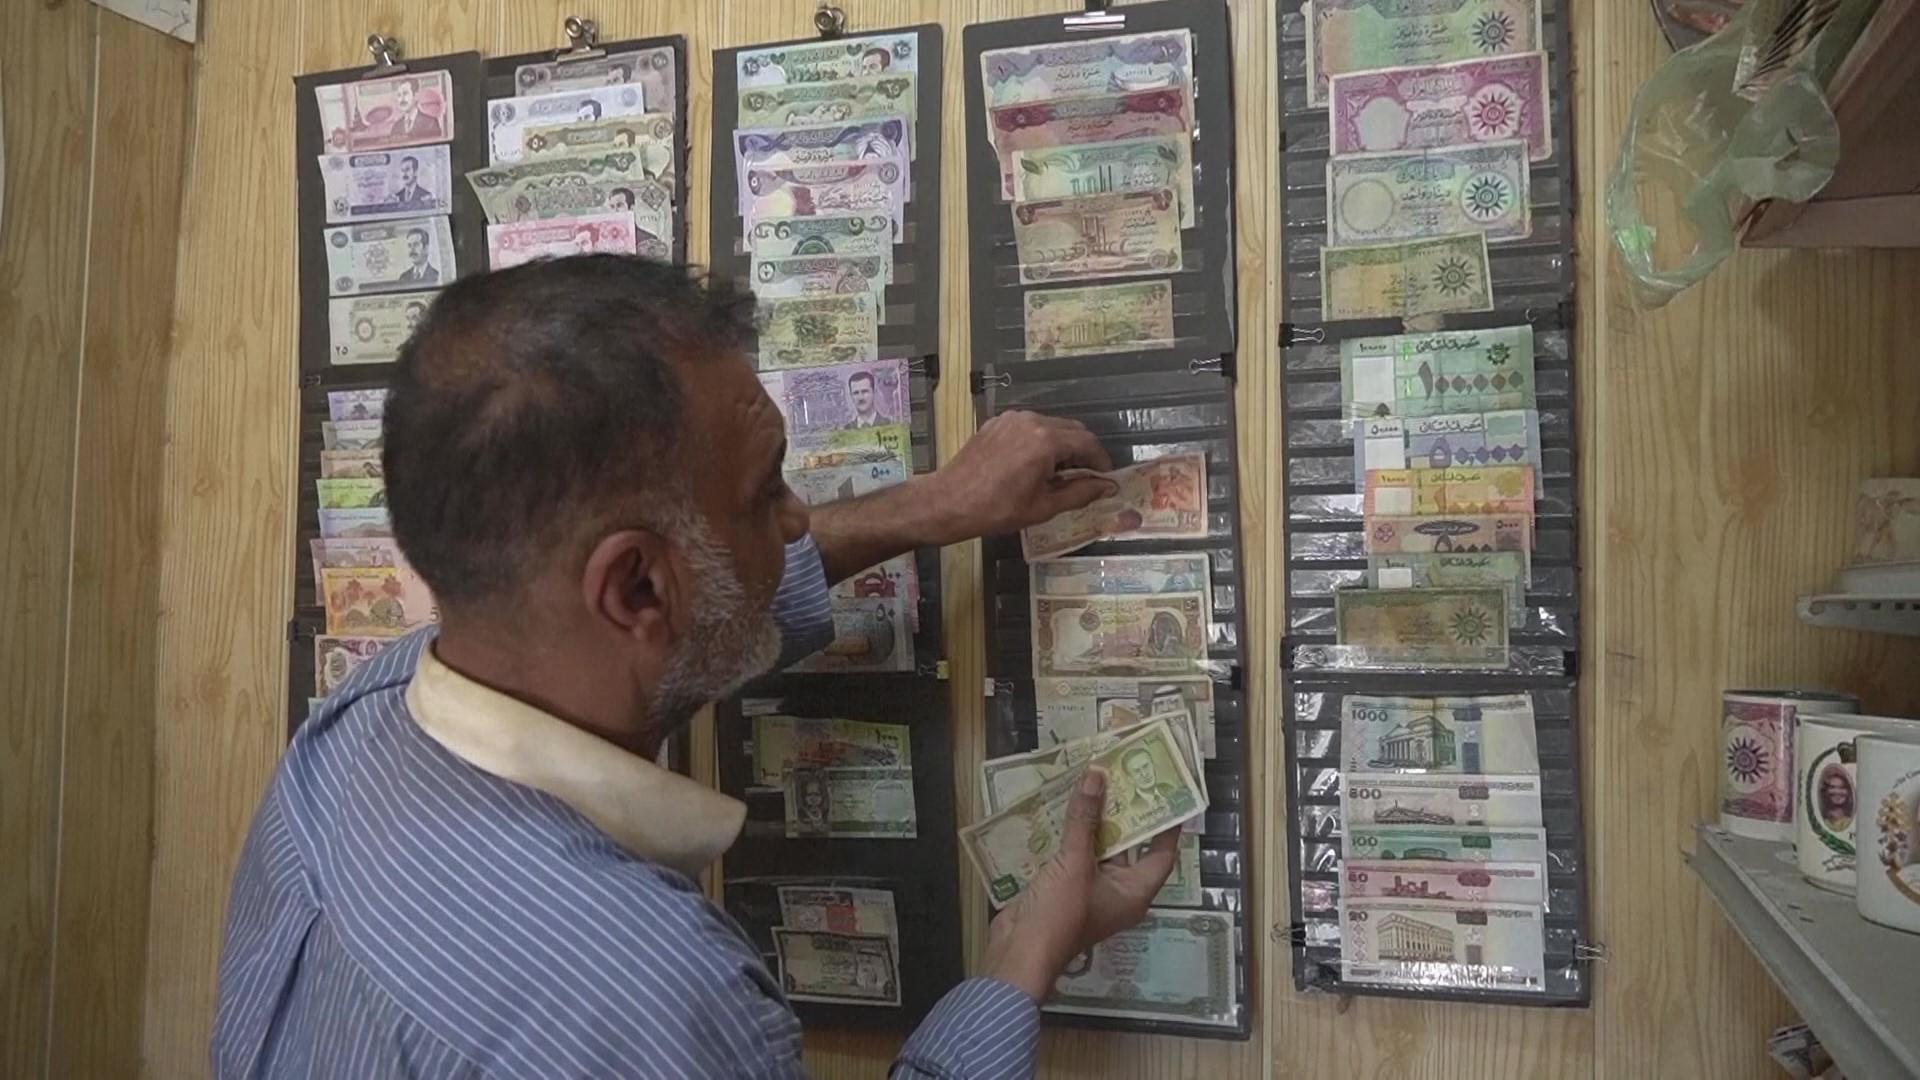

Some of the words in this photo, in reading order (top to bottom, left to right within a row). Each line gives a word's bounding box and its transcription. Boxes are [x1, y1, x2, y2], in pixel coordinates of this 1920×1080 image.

[335, 346, 348, 356] ٢٥
[877, 431, 898, 449] ١٠٠٠
[871, 467, 891, 479] ٥٠٠
[1496, 519, 1520, 529] ٥٠٠٠
[430, 606, 440, 623] 5
[1351, 709, 1389, 722] 1000
[1349, 788, 1382, 800] 500
[1352, 836, 1379, 847] 100
[1349, 873, 1369, 883] 50
[1349, 911, 1369, 922] 20
